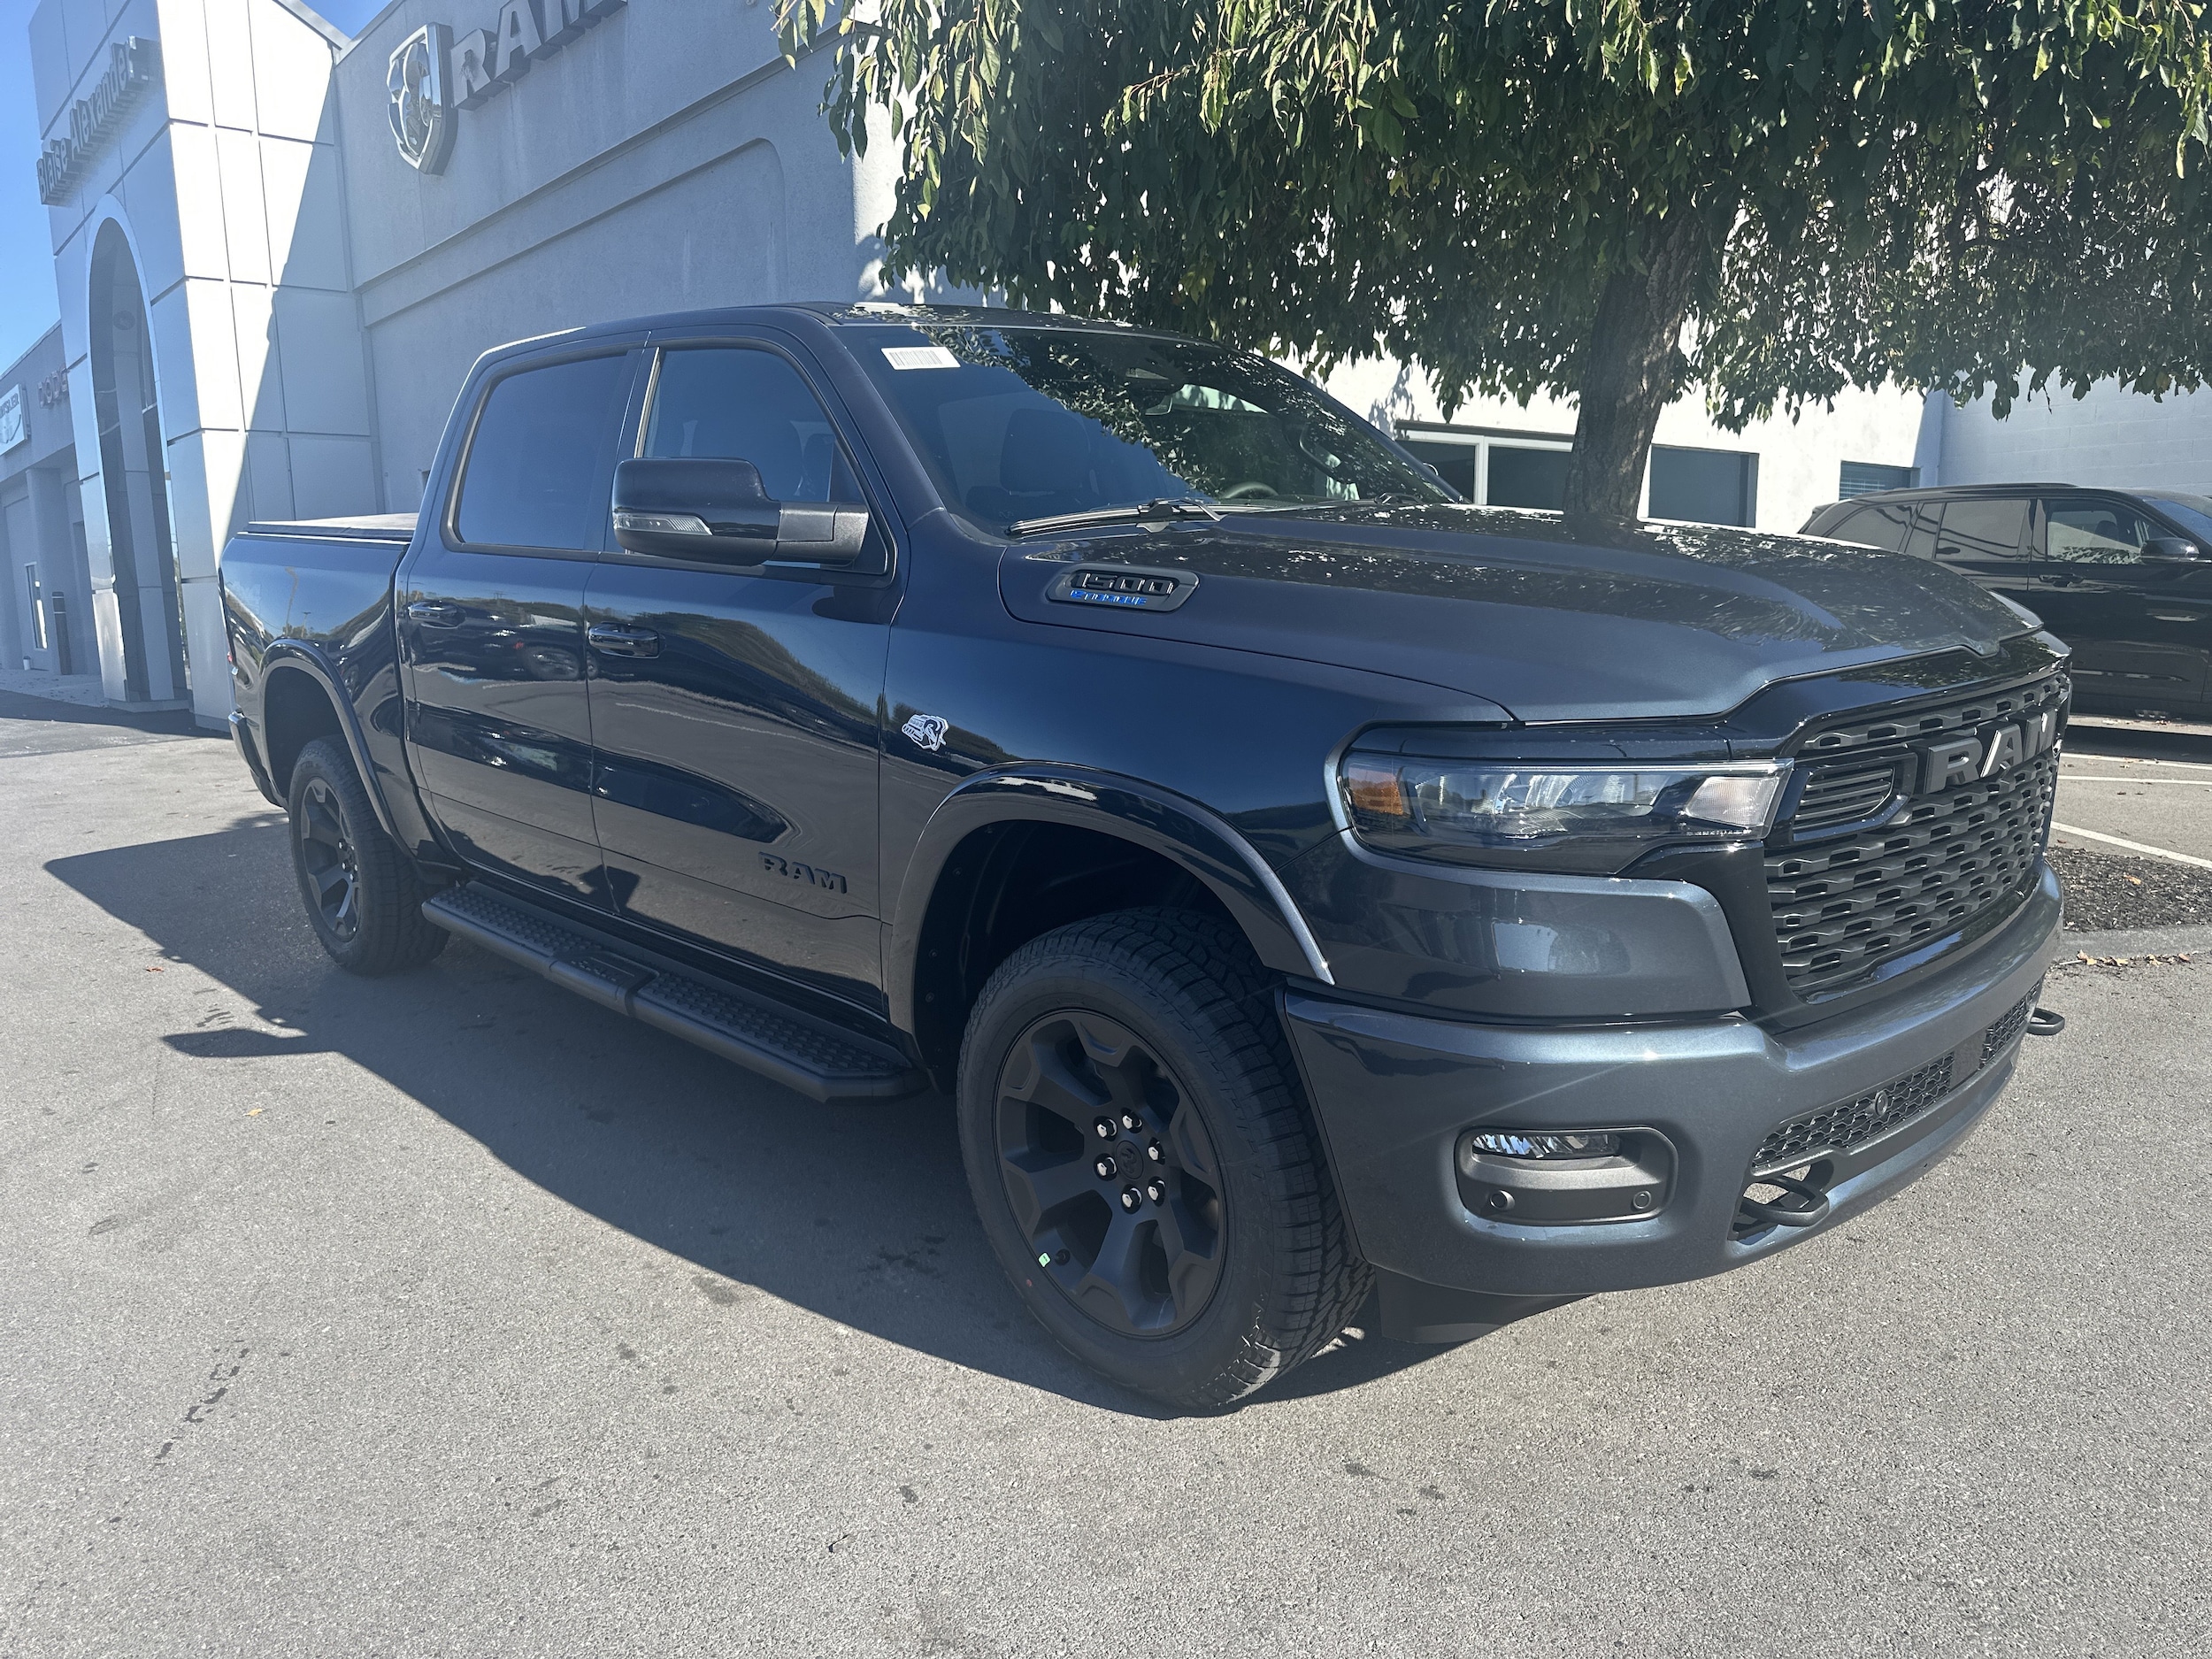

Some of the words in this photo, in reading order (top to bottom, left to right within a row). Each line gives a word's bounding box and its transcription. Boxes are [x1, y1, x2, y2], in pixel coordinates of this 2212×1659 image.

[450, 0, 611, 110] RA
[36, 138, 70, 202] Blaise
[69, 36, 137, 160] Alexander
[1075, 573, 1175, 596] 1500
[1924, 707, 2056, 795] RAM
[758, 851, 848, 895] RAM
